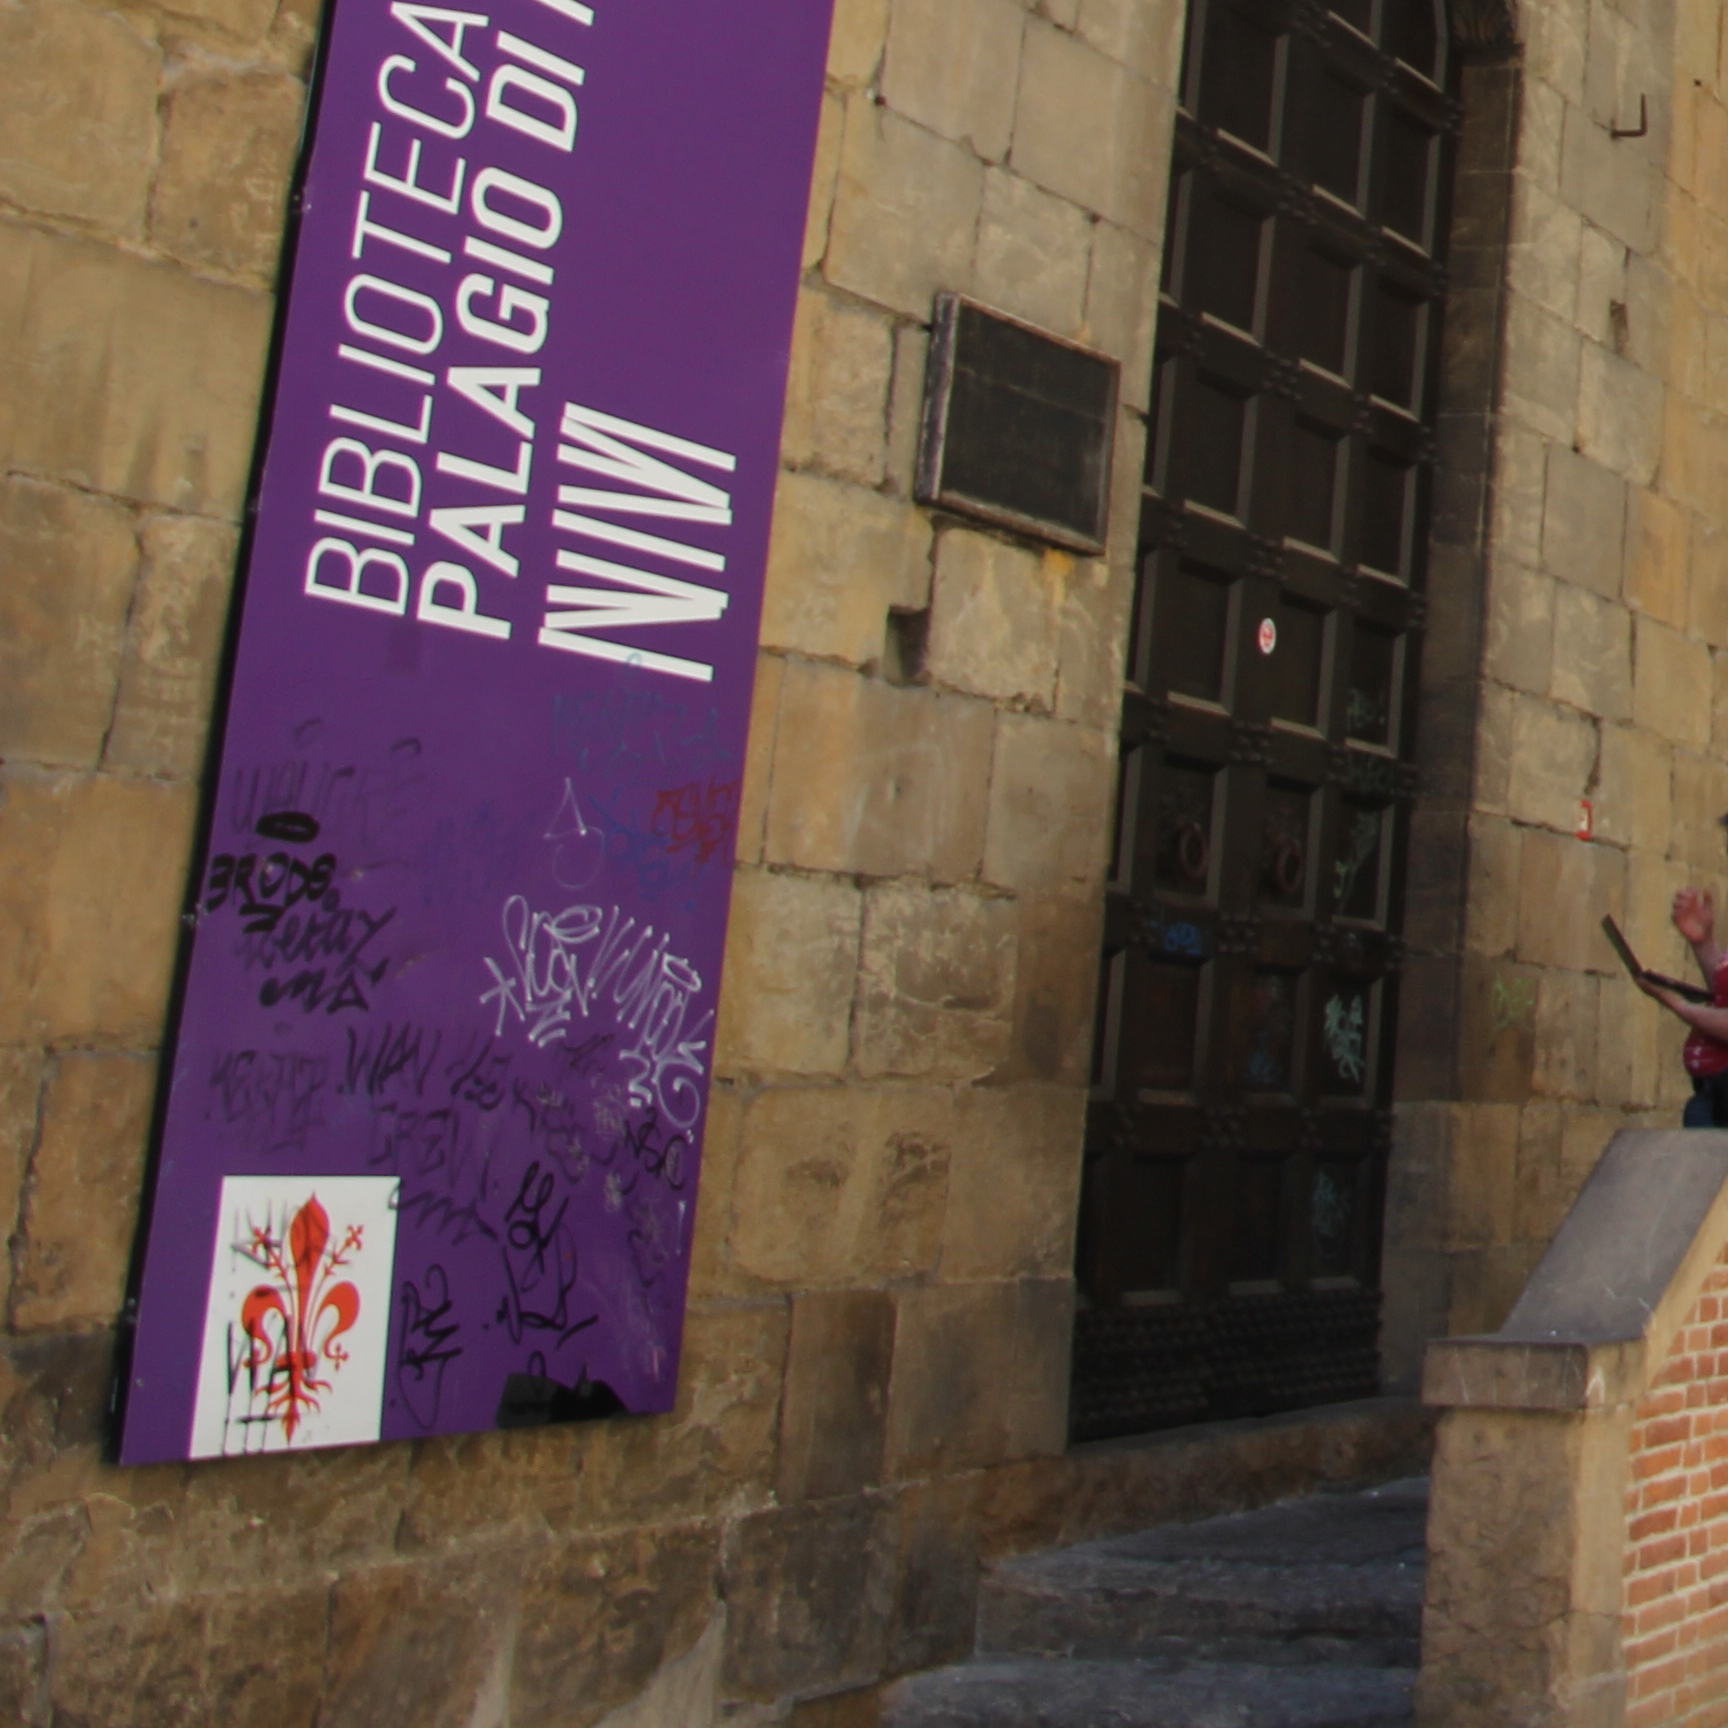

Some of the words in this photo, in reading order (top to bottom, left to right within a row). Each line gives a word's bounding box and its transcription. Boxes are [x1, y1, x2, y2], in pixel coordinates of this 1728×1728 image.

[306, 2, 488, 615] BIBLIOTECA
[487, 32, 584, 151] DI
[418, 168, 562, 638] PALAGIO
